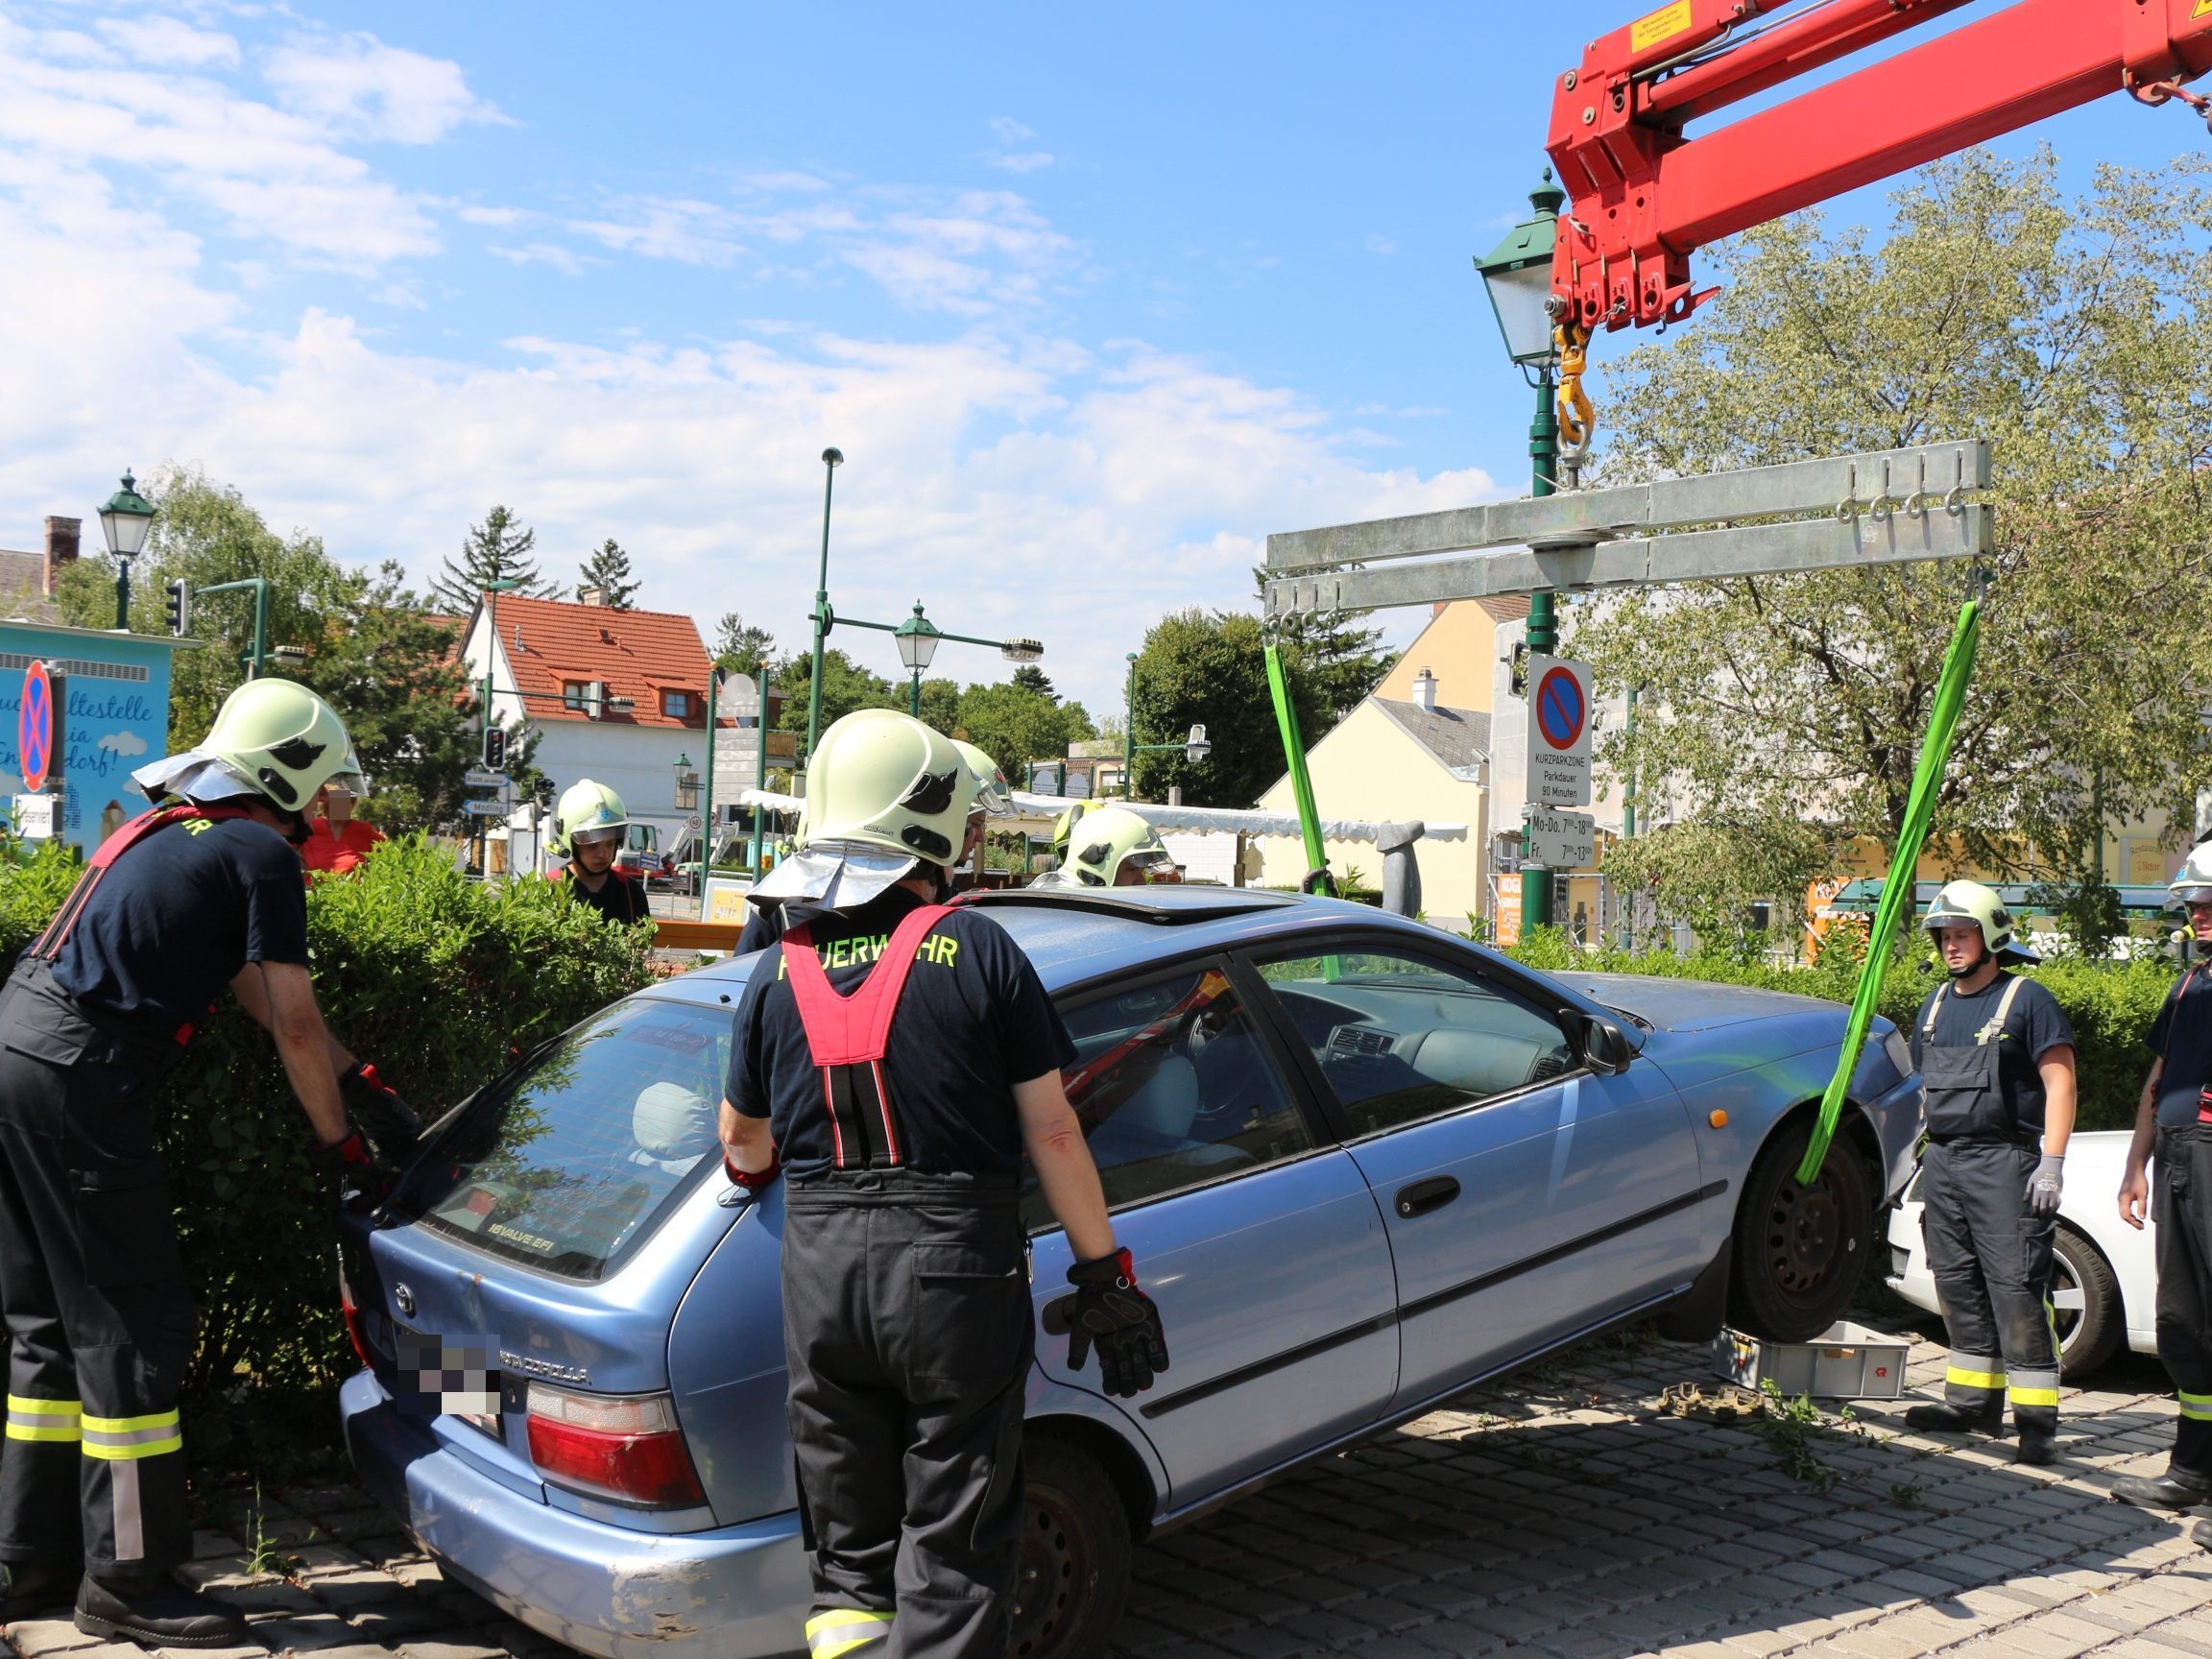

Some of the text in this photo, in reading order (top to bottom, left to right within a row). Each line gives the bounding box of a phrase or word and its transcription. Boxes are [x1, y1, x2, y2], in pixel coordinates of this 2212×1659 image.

[1535, 753, 1586, 768] KURZPARKZONE
[1544, 770, 1577, 783] Parkdauer
[1542, 785, 1577, 799] 90 Minuten
[1532, 815, 1561, 833] Mo-Do.
[1531, 842, 1542, 858] Fr.
[532, 1237, 555, 1252] EFI
[523, 1357, 593, 1385] COROLLA
